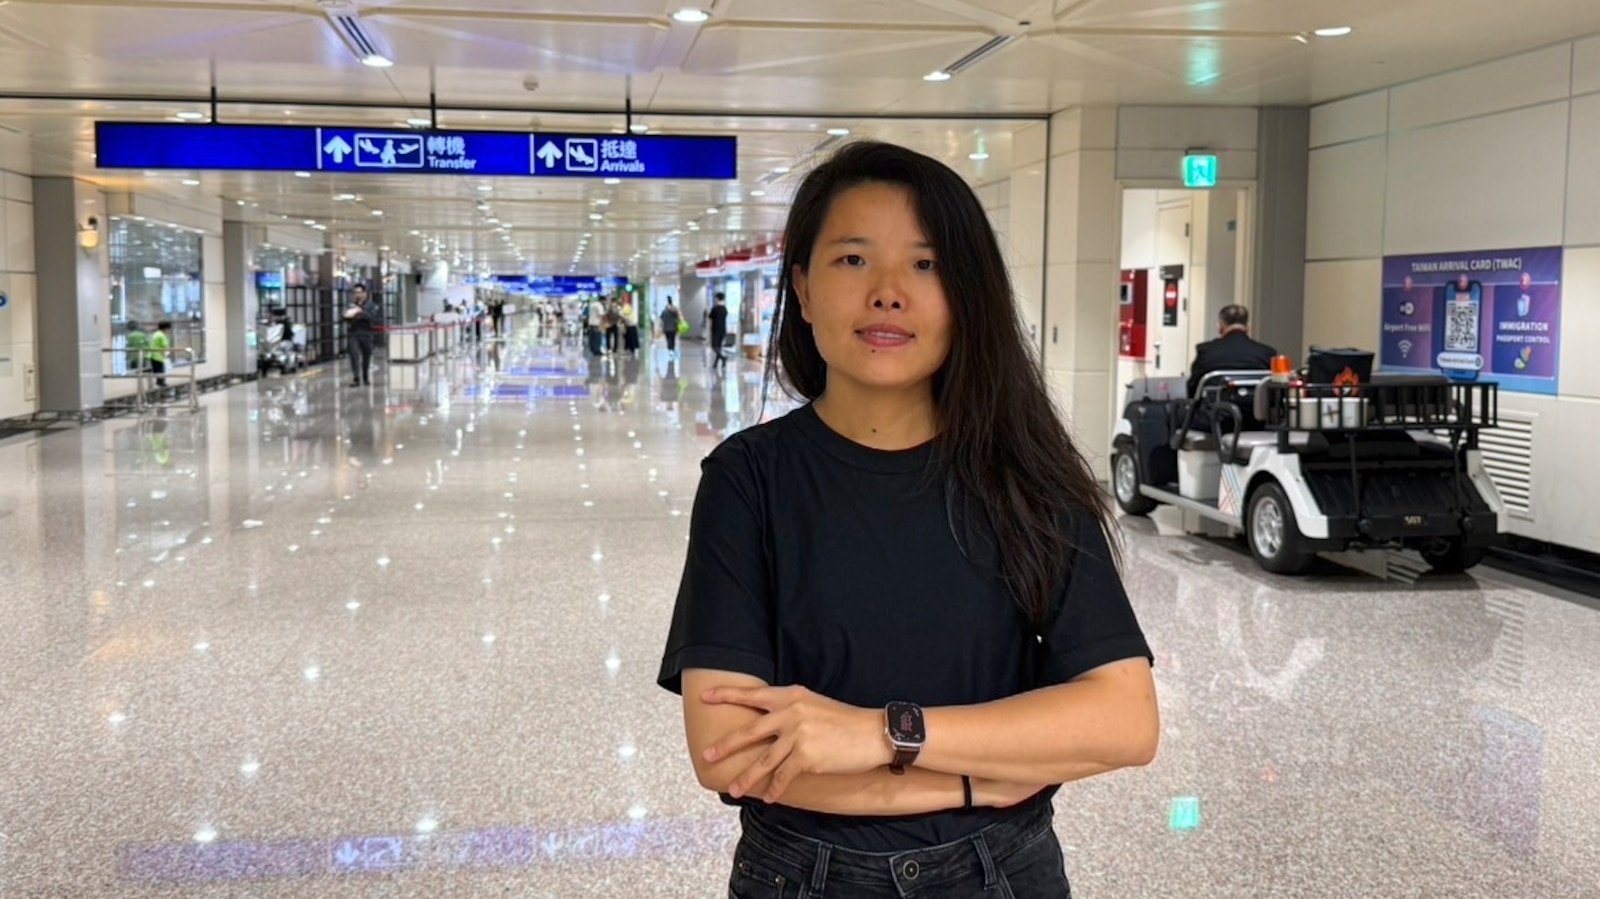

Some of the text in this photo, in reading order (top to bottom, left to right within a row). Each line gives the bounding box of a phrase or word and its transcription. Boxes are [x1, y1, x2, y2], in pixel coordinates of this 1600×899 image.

[427, 135, 466, 155] 轉機
[601, 139, 638, 159] 抵達
[427, 155, 477, 169] Transfer
[600, 159, 646, 172] Arrivals
[1411, 257, 1522, 272] TAIWAN ARRIVAL CARD (TWAC)
[1384, 322, 1404, 333] Airport
[1404, 323, 1417, 332] Free
[1499, 321, 1548, 331] IMMIGRATION
[1496, 334, 1551, 344] PASSPORT CONTROL
